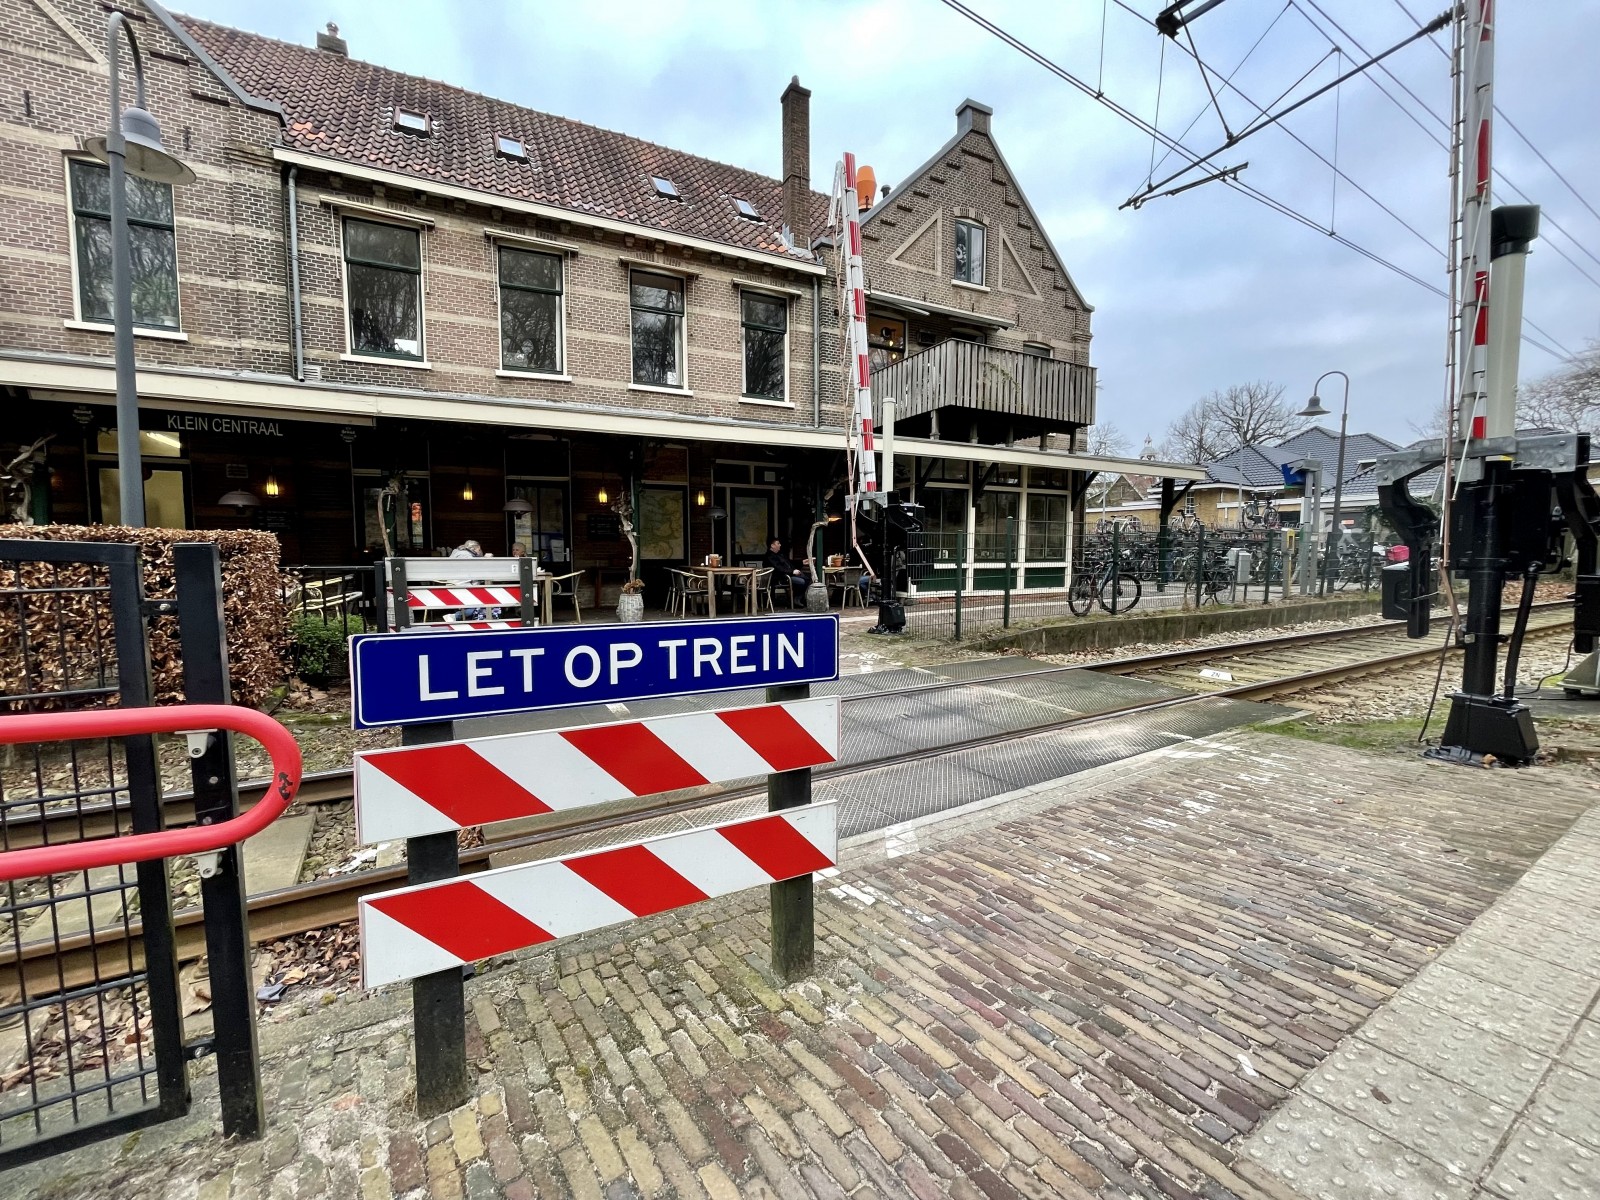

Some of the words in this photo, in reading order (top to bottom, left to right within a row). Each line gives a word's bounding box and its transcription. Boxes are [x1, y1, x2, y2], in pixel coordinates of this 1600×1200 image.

[167, 414, 208, 431] KLEIN
[212, 418, 283, 436] CENTRAAL
[418, 647, 545, 702] LET
[564, 643, 643, 688] OP
[658, 631, 804, 680] TREIN
